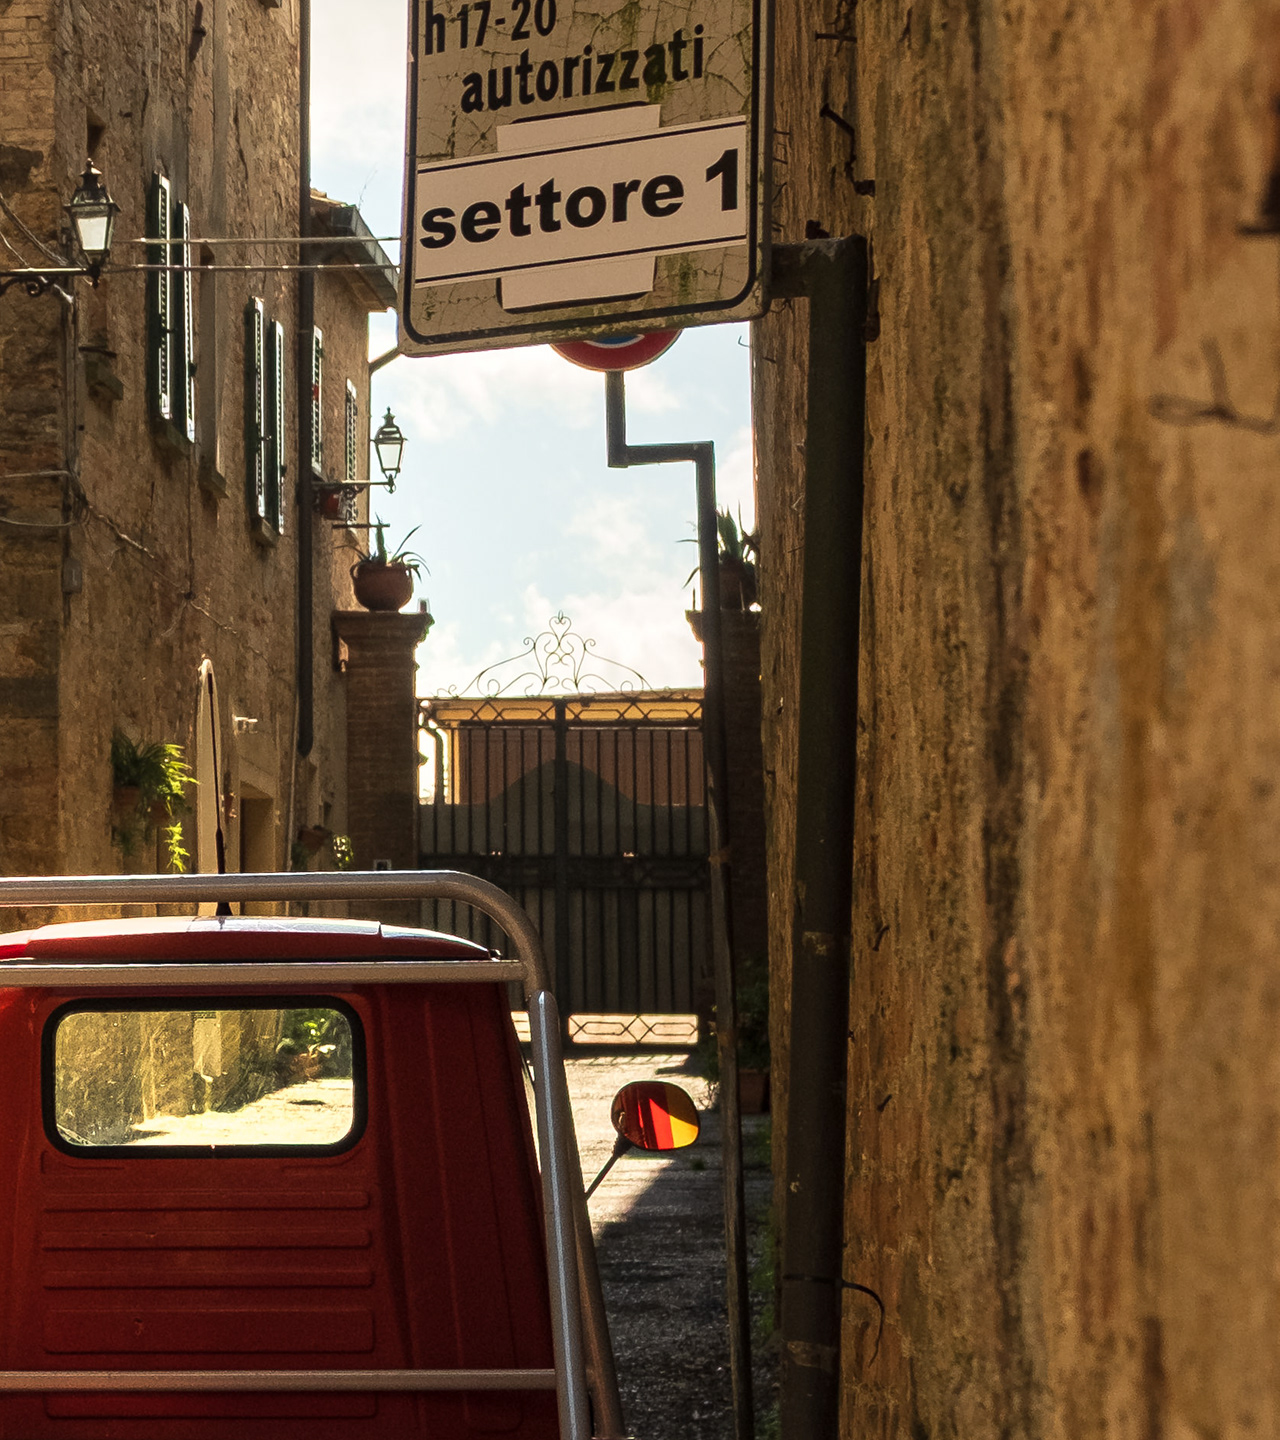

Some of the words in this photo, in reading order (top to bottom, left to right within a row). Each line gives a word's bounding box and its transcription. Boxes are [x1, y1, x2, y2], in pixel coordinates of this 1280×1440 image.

[460, 24, 704, 114] autorizzati
[419, 177, 684, 250] settore
[705, 148, 739, 212] 1
